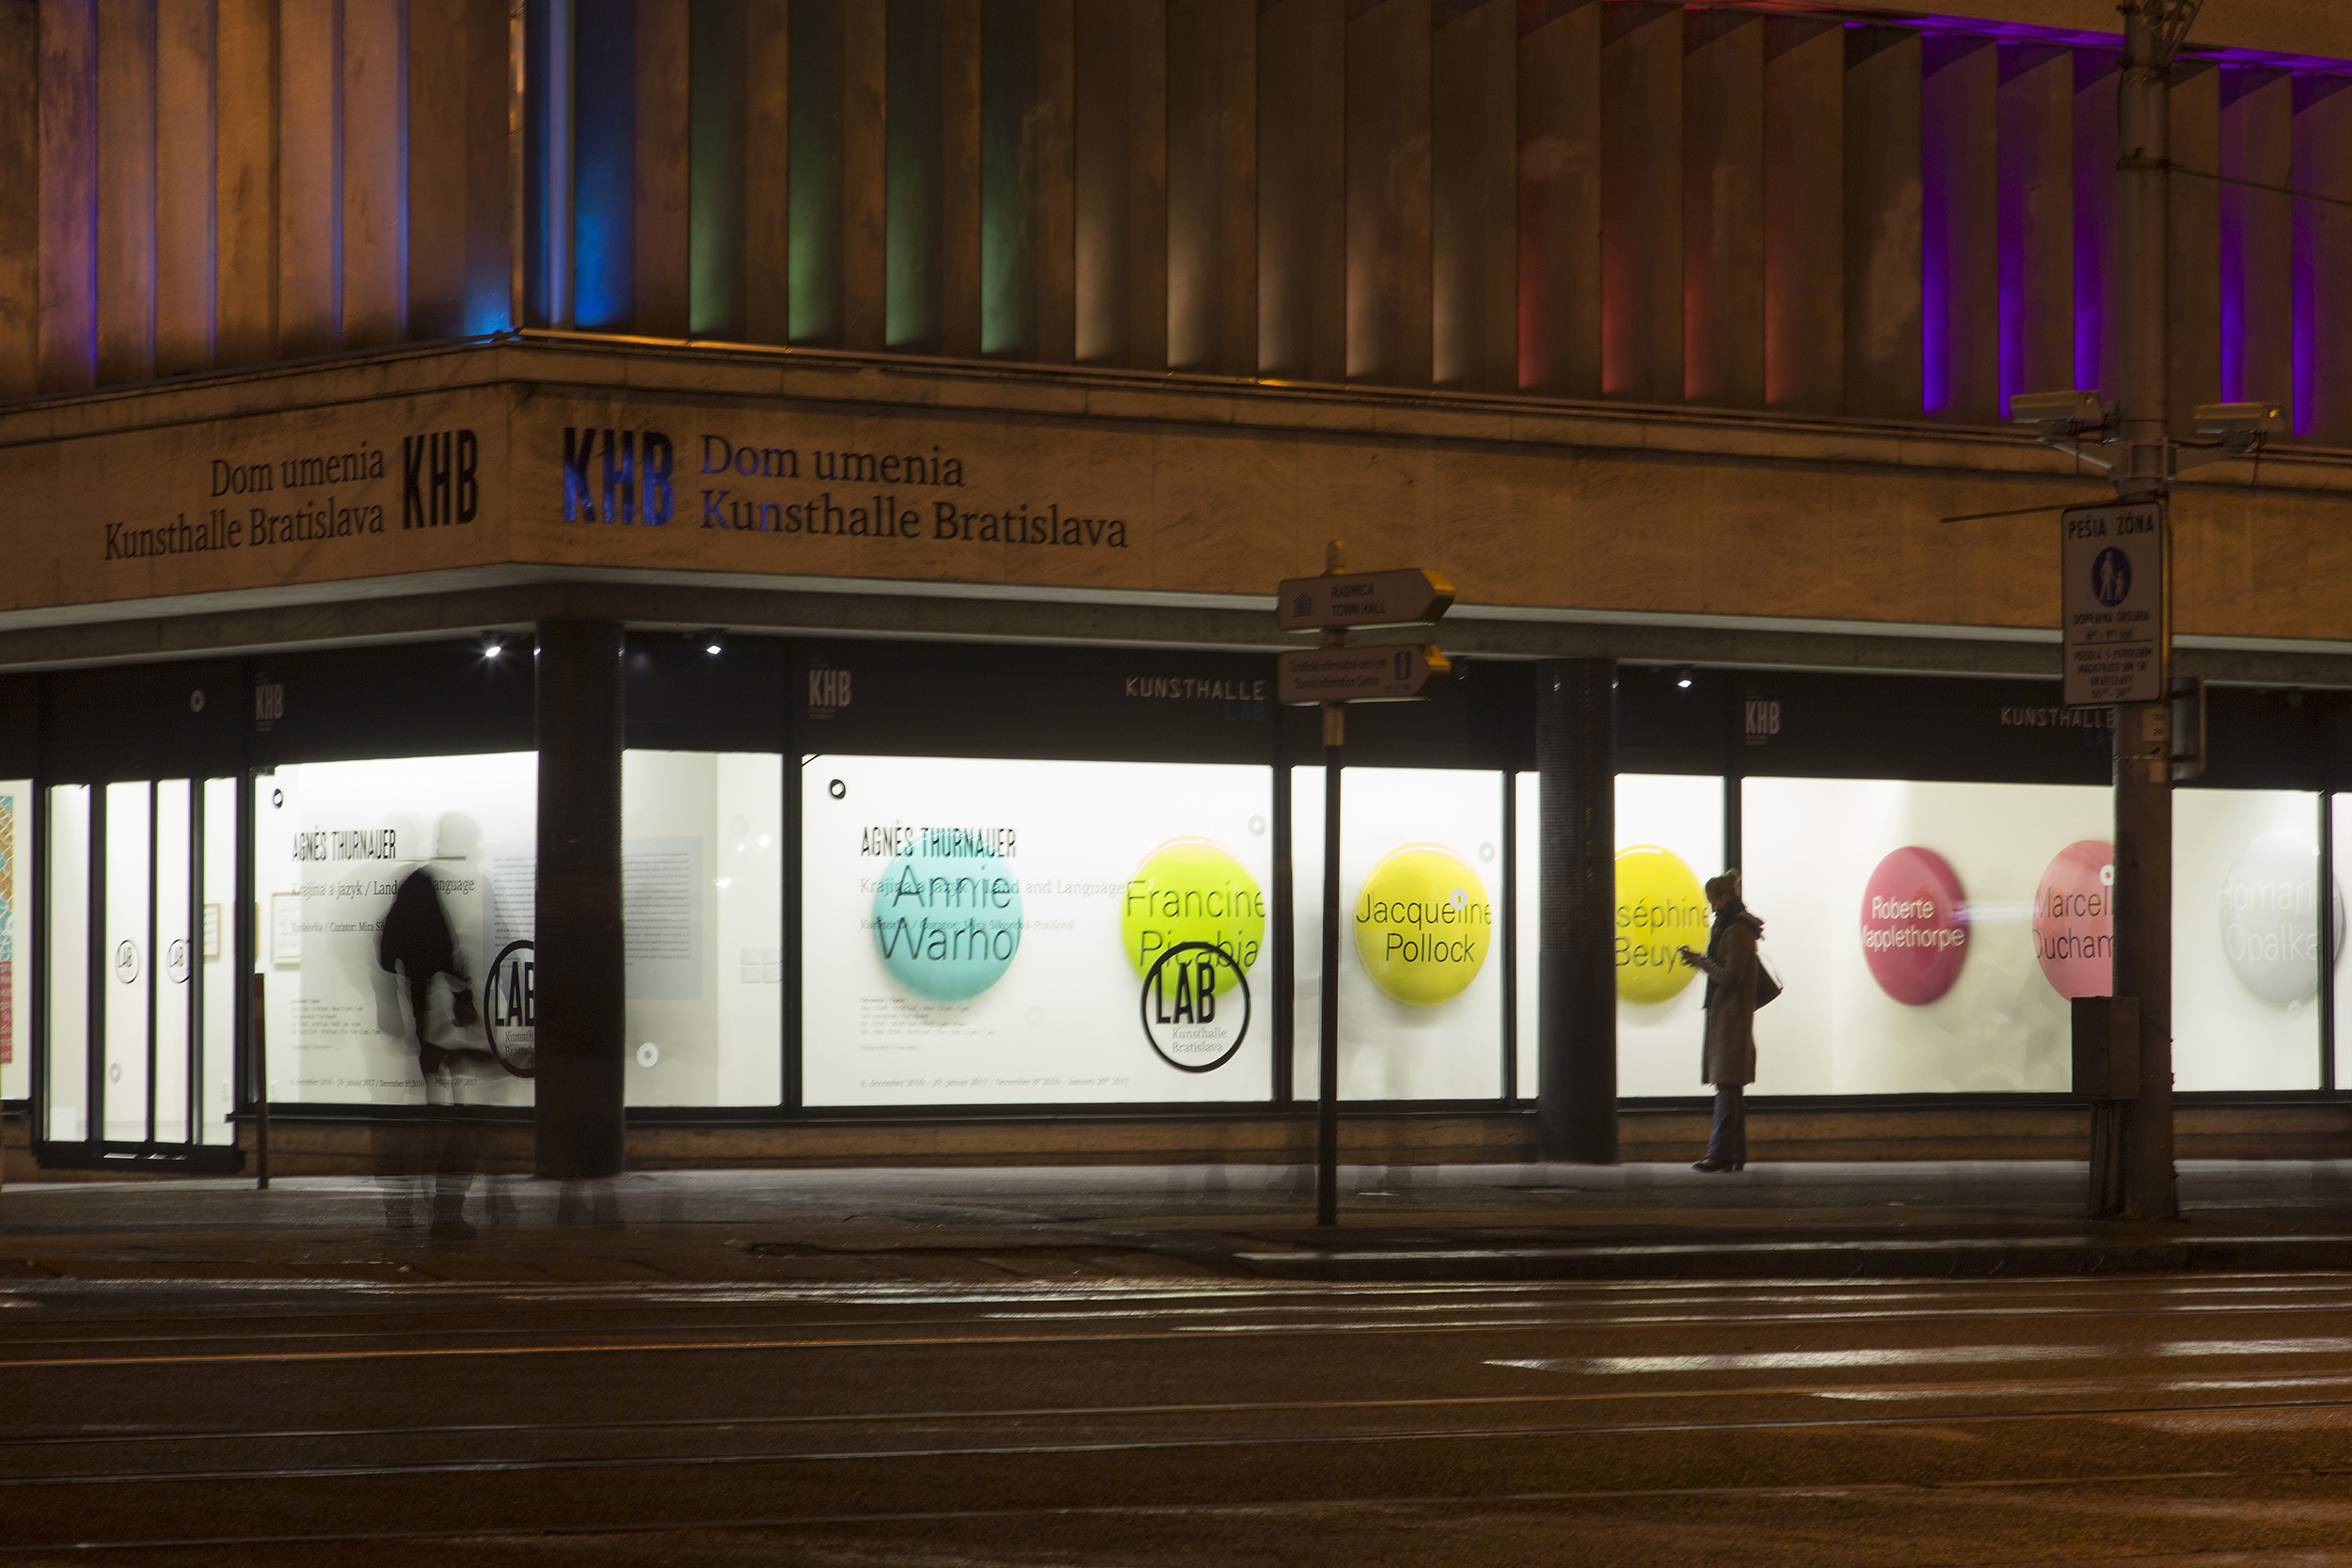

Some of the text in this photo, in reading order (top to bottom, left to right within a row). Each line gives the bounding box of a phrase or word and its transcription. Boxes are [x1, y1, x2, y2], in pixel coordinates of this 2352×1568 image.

[212, 441, 386, 499] Dom umenia
[563, 426, 675, 527] KHB
[700, 434, 964, 487] Dom umenia
[403, 428, 480, 531] KHB
[104, 498, 386, 562] Kunsthalle Bratislava
[700, 488, 1129, 549] Kunsthalle Bratislava
[2116, 511, 2154, 536] ZÓNA
[1331, 603, 1359, 617] TOWN
[255, 683, 285, 721] KHB
[808, 669, 852, 707] KHB
[1125, 676, 1266, 703] KUNSTHALLE
[1225, 703, 1266, 722] LAB
[1744, 700, 1781, 736] KHB
[2001, 706, 2113, 730] KUNSTHALLE
[331, 829, 396, 862] THURNAUER
[920, 826, 1016, 858] THURNAUER
[336, 880, 363, 900] jazyk
[373, 879, 398, 895] Land
[433, 879, 475, 895] anguage
[891, 863, 1012, 910] Annie
[1025, 879, 1051, 895] and
[1056, 879, 1125, 898] Language
[1125, 879, 1266, 919] Francine
[2033, 886, 2115, 918] Marcell
[2222, 880, 2333, 911] oman
[1356, 894, 1492, 931] Jacqueline
[1615, 896, 1710, 935] séphine
[1871, 895, 1936, 920] Roberte
[1386, 932, 1475, 963] Pollock
[2032, 927, 2114, 959] Ducham
[2226, 923, 2319, 970] Opalka
[494, 960, 534, 1027] LAB
[1154, 961, 1216, 1025] LAB
[504, 1031, 534, 1043] Kunsth
[1171, 1026, 1228, 1040] Kunsthalle
[1171, 1041, 1223, 1053] Bratislava
[504, 1044, 535, 1057] Bratisla
